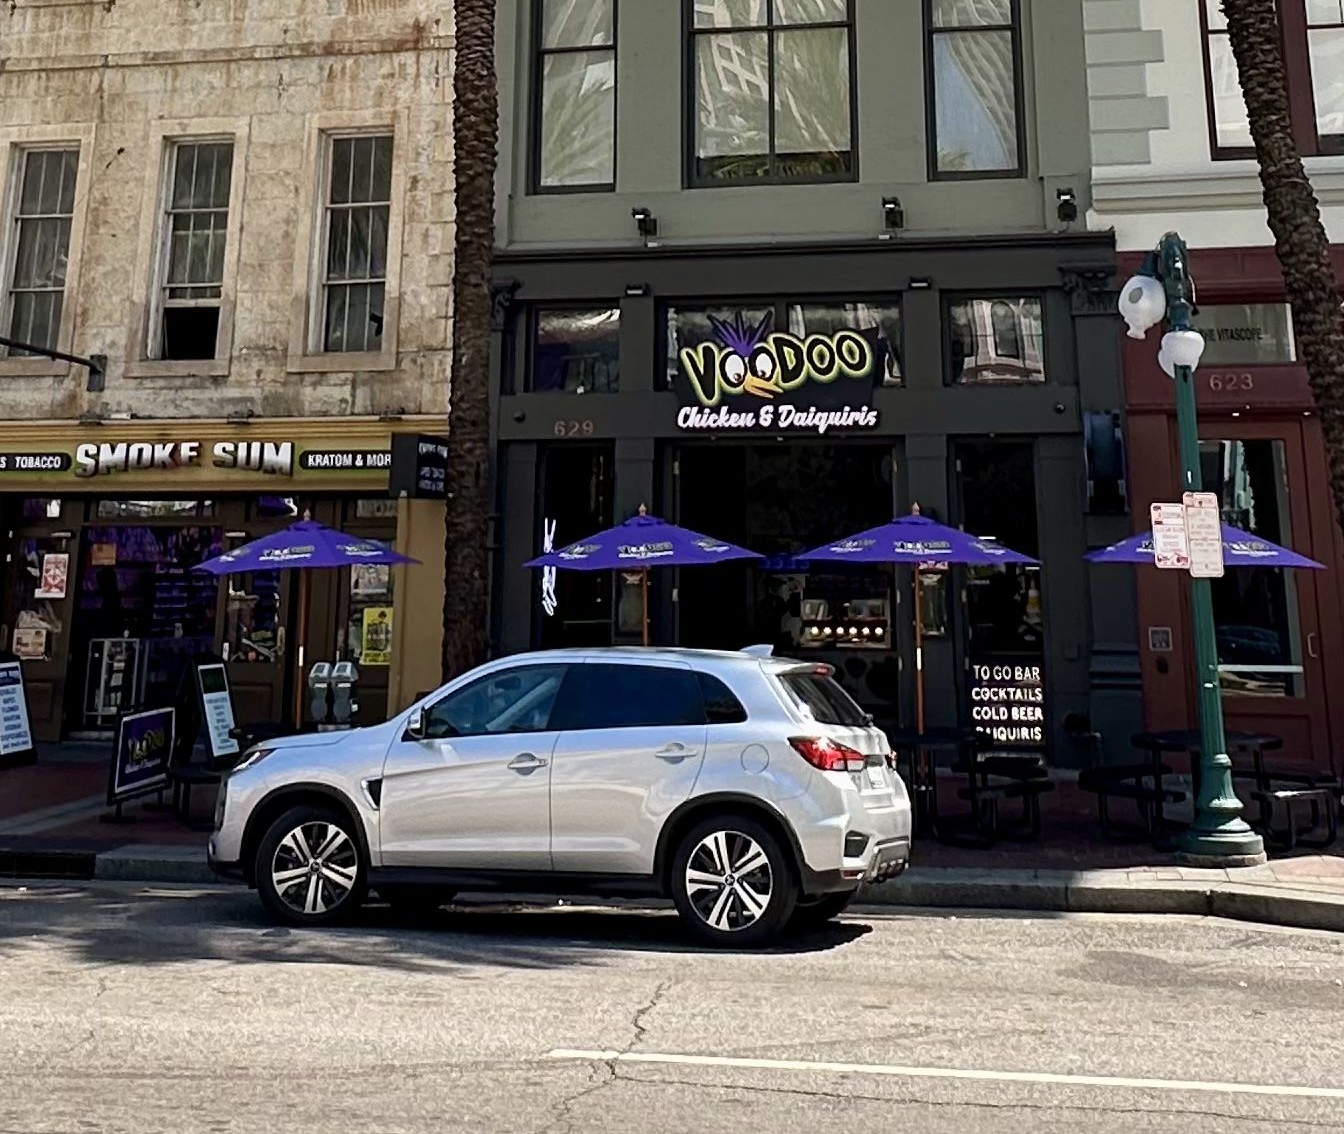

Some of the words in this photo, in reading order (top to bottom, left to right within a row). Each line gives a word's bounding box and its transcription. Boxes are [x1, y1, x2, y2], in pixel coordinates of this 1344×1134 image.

[680, 330, 873, 407] VOODOO
[1209, 373, 1254, 391] 623
[677, 406, 756, 428] Chicken
[759, 405, 774, 426] &
[778, 404, 878, 434] Daiquiris
[553, 420, 594, 436] 629
[14, 455, 62, 469] TOBACCO
[74, 441, 201, 478] SMOKE
[212, 441, 294, 477] SUM
[307, 453, 353, 467] KRATOM
[355, 453, 364, 466] &
[366, 453, 392, 466] MOR
[973, 665, 990, 680] TO
[993, 665, 1012, 681] GO
[1014, 666, 1041, 681] BAR
[971, 687, 1043, 701] COCKTAILS
[972, 706, 1008, 721] COLD
[1011, 706, 1044, 721] BEER
[976, 726, 1042, 741] IQUIRIS
